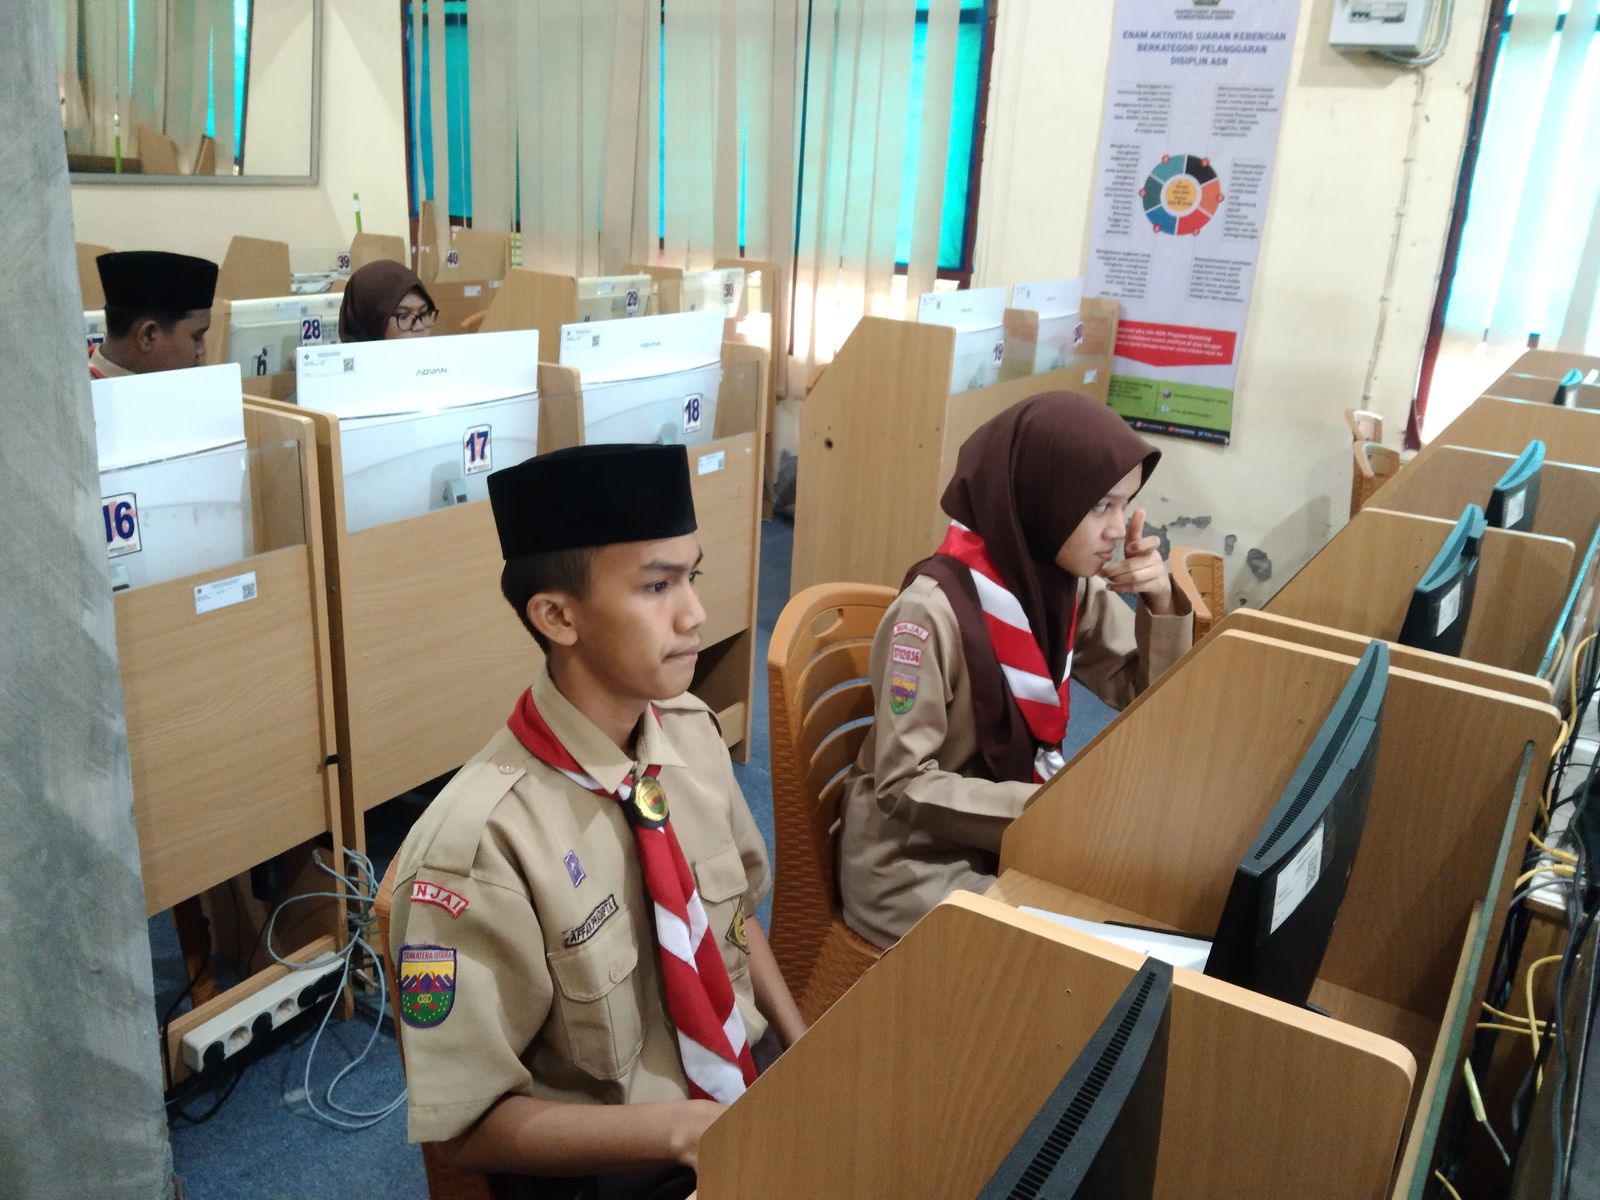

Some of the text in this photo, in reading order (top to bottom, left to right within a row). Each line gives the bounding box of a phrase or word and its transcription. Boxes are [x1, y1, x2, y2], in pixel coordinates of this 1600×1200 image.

[1122, 30, 1287, 41] ENAM AKTIVITAS UJARAN KEBENCIAN
[1137, 43, 1267, 54] BERKATEGORI PELANGGARAN
[1170, 56, 1228, 66] DISIPLIN ASN
[338, 255, 350, 269] 39
[447, 251, 458, 265] 40
[723, 283, 734, 298] 30
[627, 290, 638, 306] 29
[302, 319, 321, 340] 28
[993, 343, 1003, 361] 19
[416, 367, 448, 377] ADVAN
[685, 398, 700, 424] 18
[465, 430, 489, 462] 17
[102, 501, 135, 543] 16
[403, 950, 453, 960] SUMATERA UTARA
